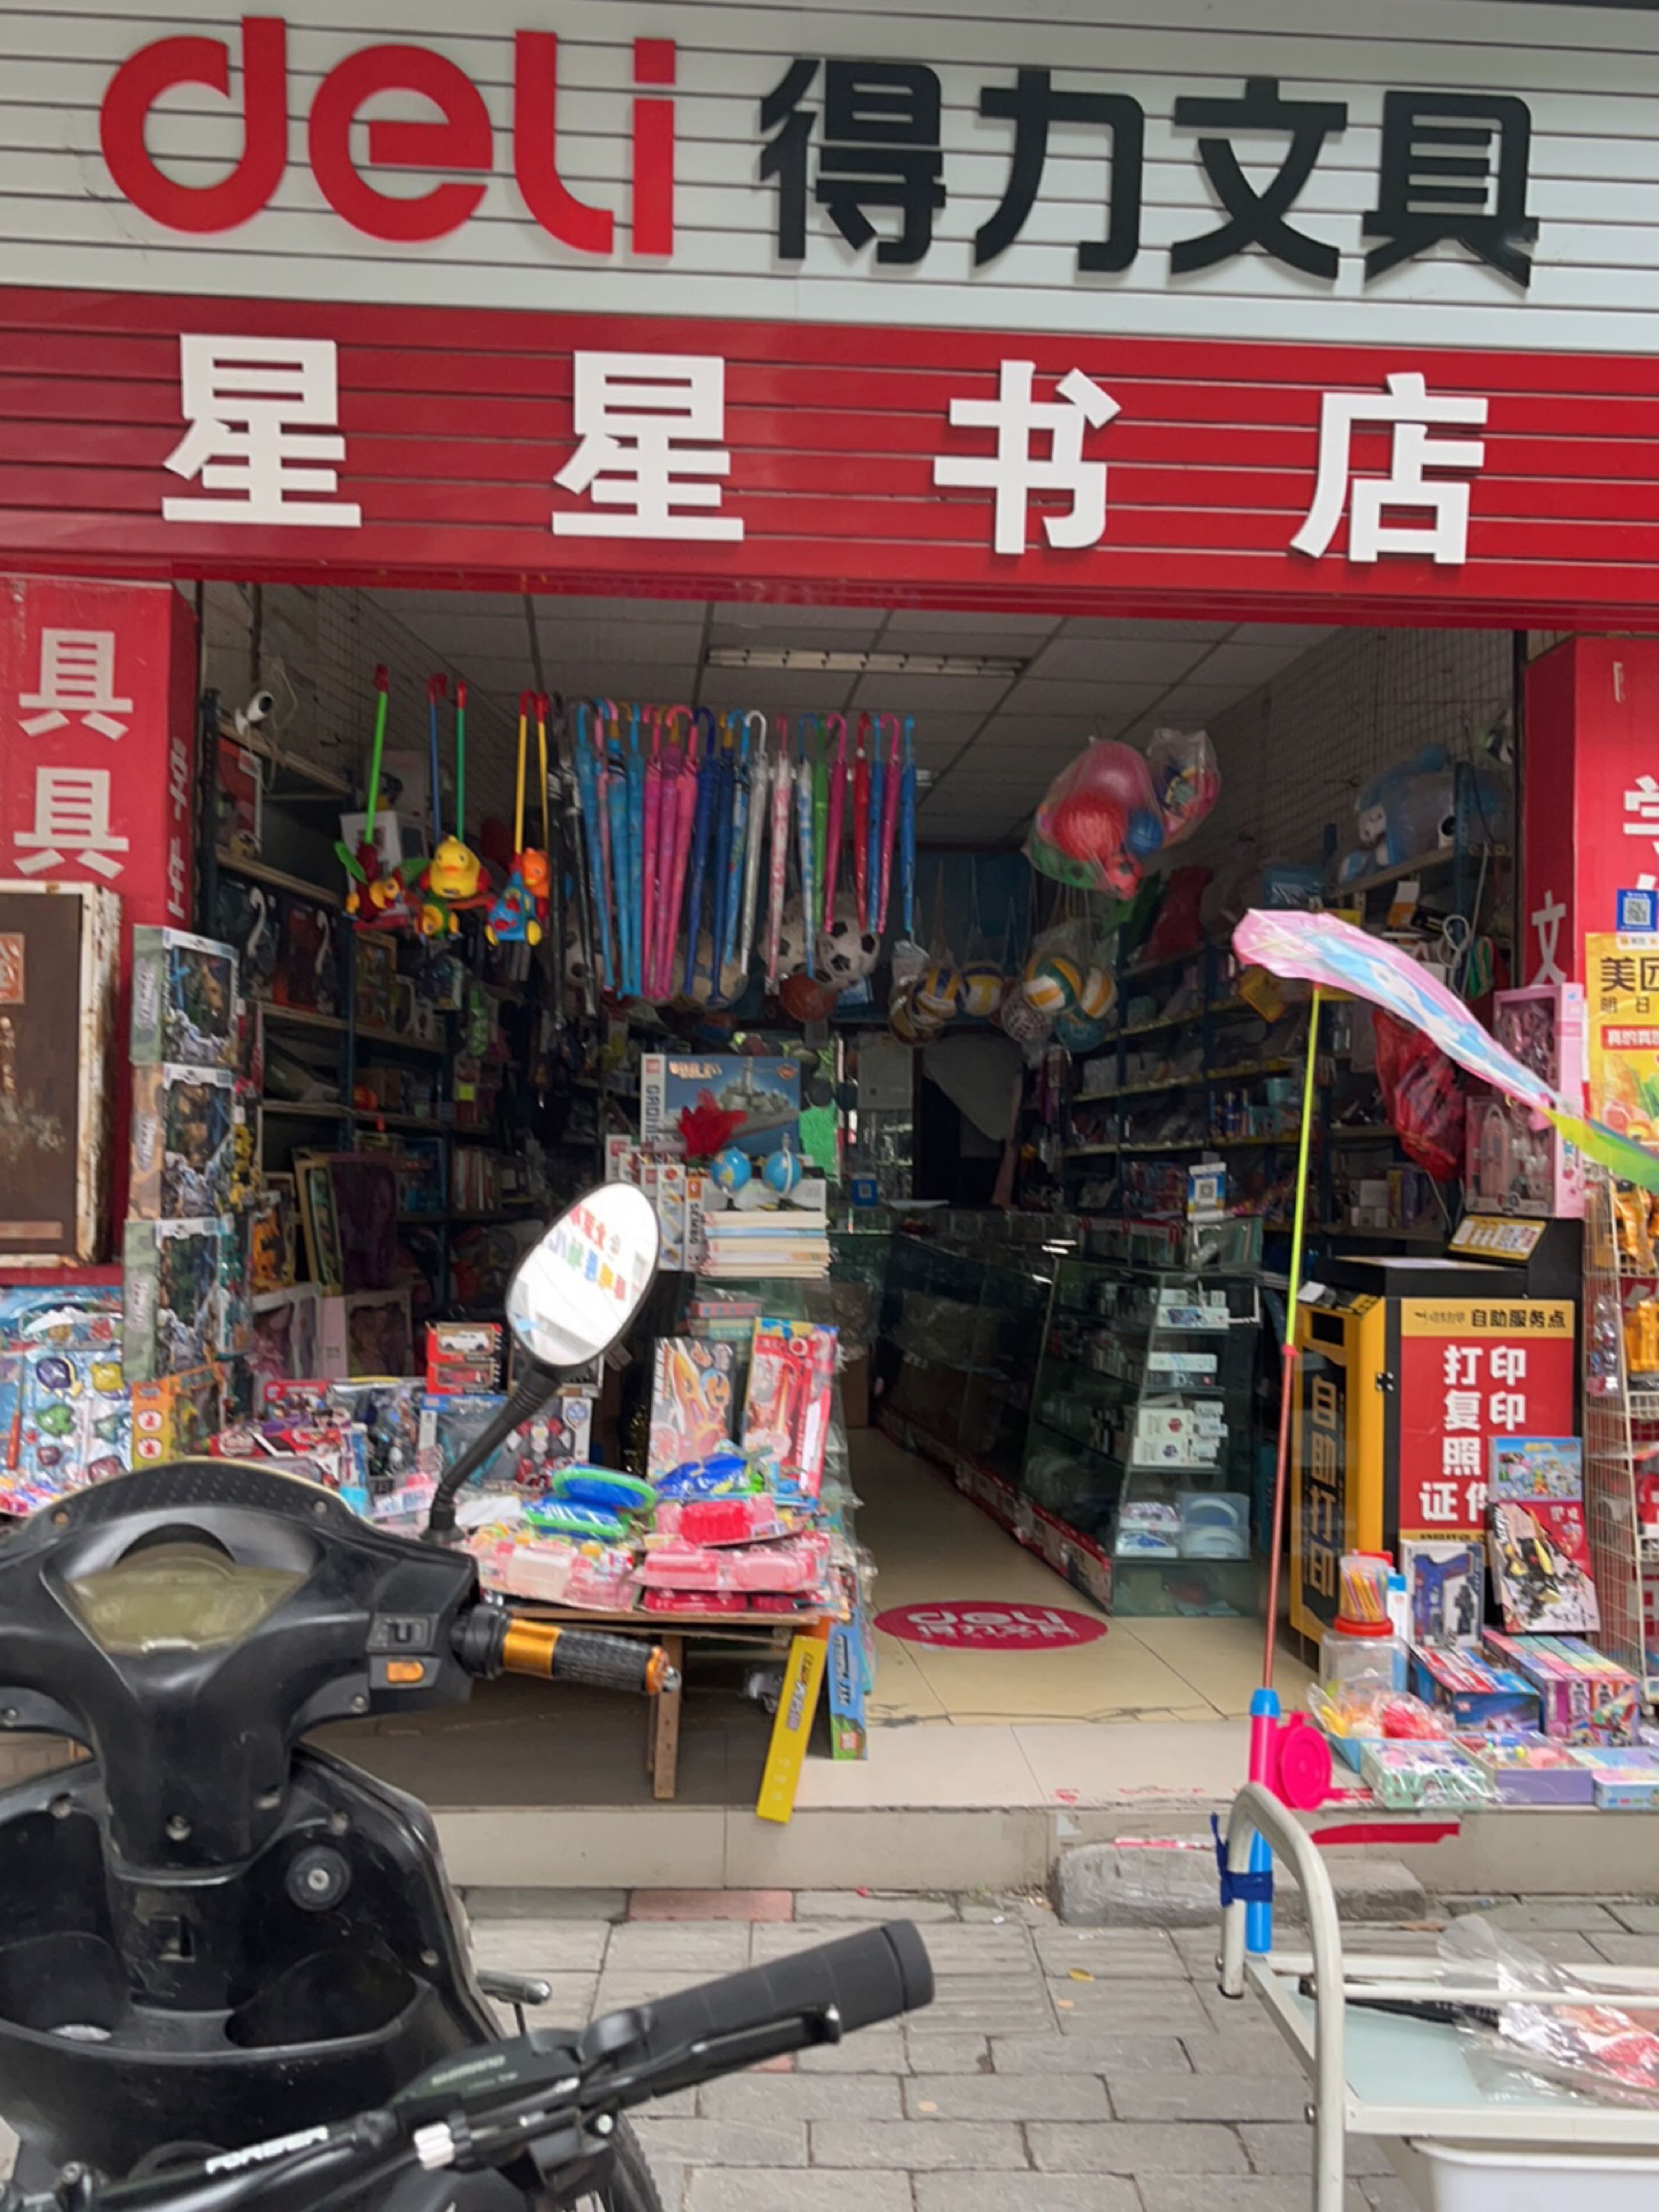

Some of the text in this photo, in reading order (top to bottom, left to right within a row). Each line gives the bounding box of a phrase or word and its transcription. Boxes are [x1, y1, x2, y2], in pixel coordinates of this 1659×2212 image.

[99, 15, 677, 255] deli
[760, 58, 1539, 289] 得力文具
[161, 332, 1489, 565] 星星书店
[17, 627, 134, 742] 具
[13, 765, 130, 879] 具
[1443, 1345, 1527, 1386] 打印
[1443, 1390, 1527, 1432] 复印
